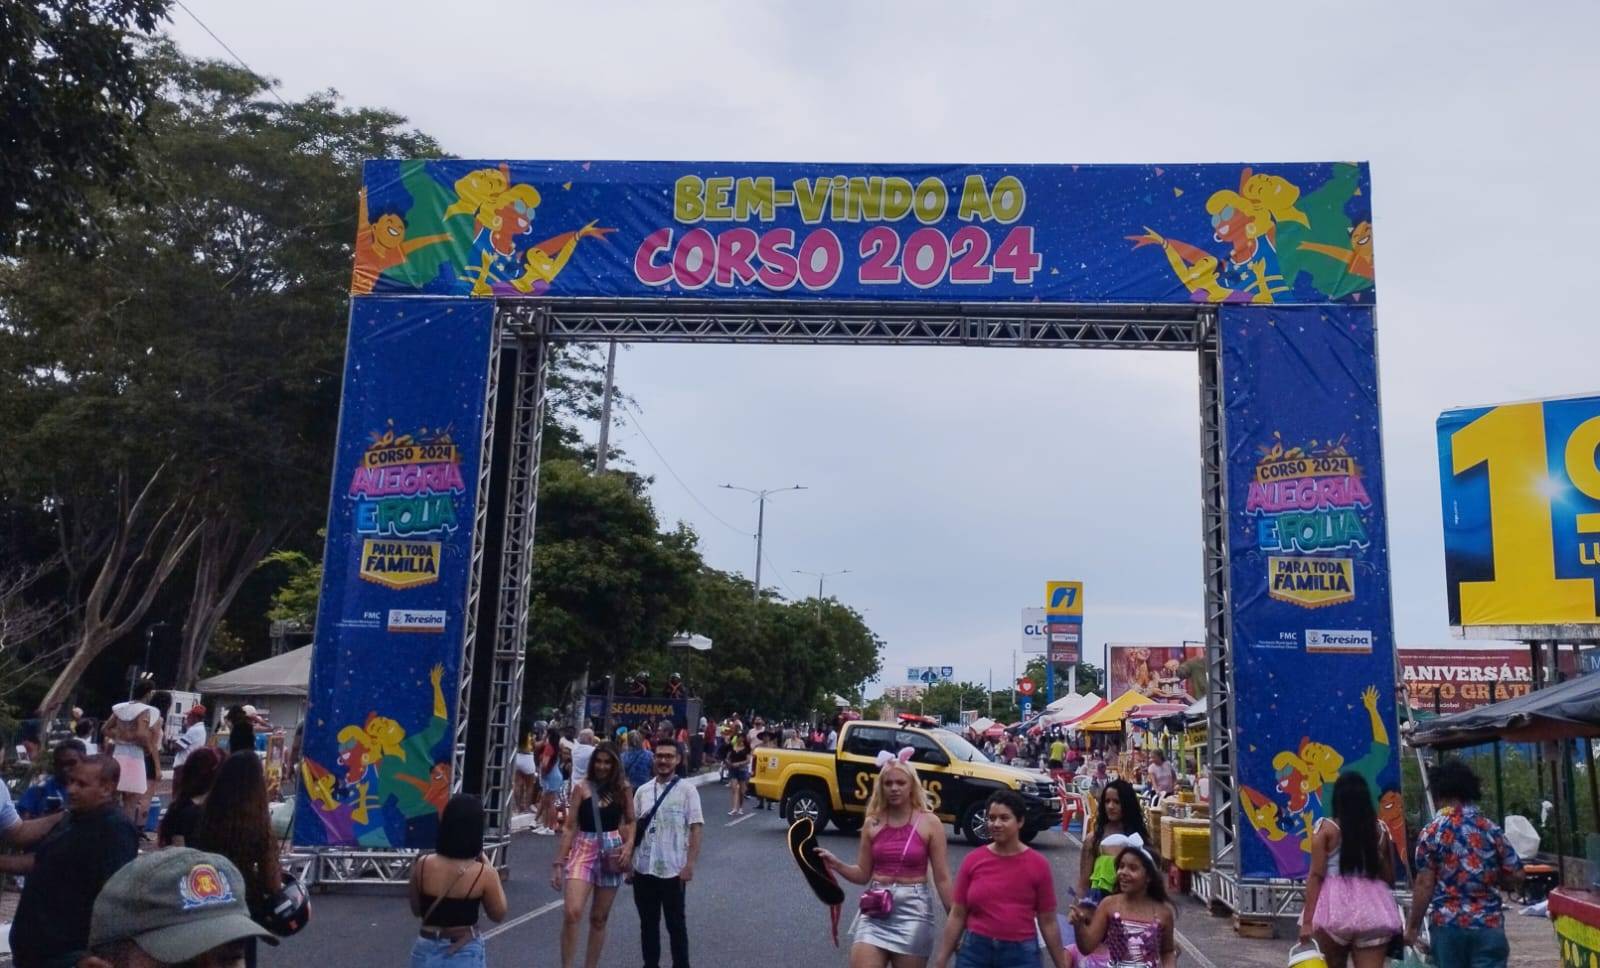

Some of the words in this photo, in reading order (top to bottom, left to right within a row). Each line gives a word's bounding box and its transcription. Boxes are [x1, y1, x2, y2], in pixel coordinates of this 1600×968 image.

[957, 174, 1026, 225] AO
[634, 227, 843, 291] CORSO
[858, 225, 1043, 289] 2024
[368, 447, 414, 465] CORSO
[419, 446, 451, 460] 2024
[1260, 460, 1307, 480] CORSO
[1312, 458, 1349, 474] 2024
[348, 462, 466, 500] ALEGRIA
[1246, 475, 1372, 516] ALEGRIA
[371, 543, 402, 556] PARA
[405, 544, 434, 557] TODA
[1278, 560, 1310, 574] PARA
[1312, 561, 1344, 575] TODA
[363, 611, 381, 620] FMC
[404, 613, 443, 624] Teresina
[1279, 631, 1297, 640] FMC
[1321, 633, 1369, 645] Teresina
[610, 702, 674, 717] SEGURANÇA
